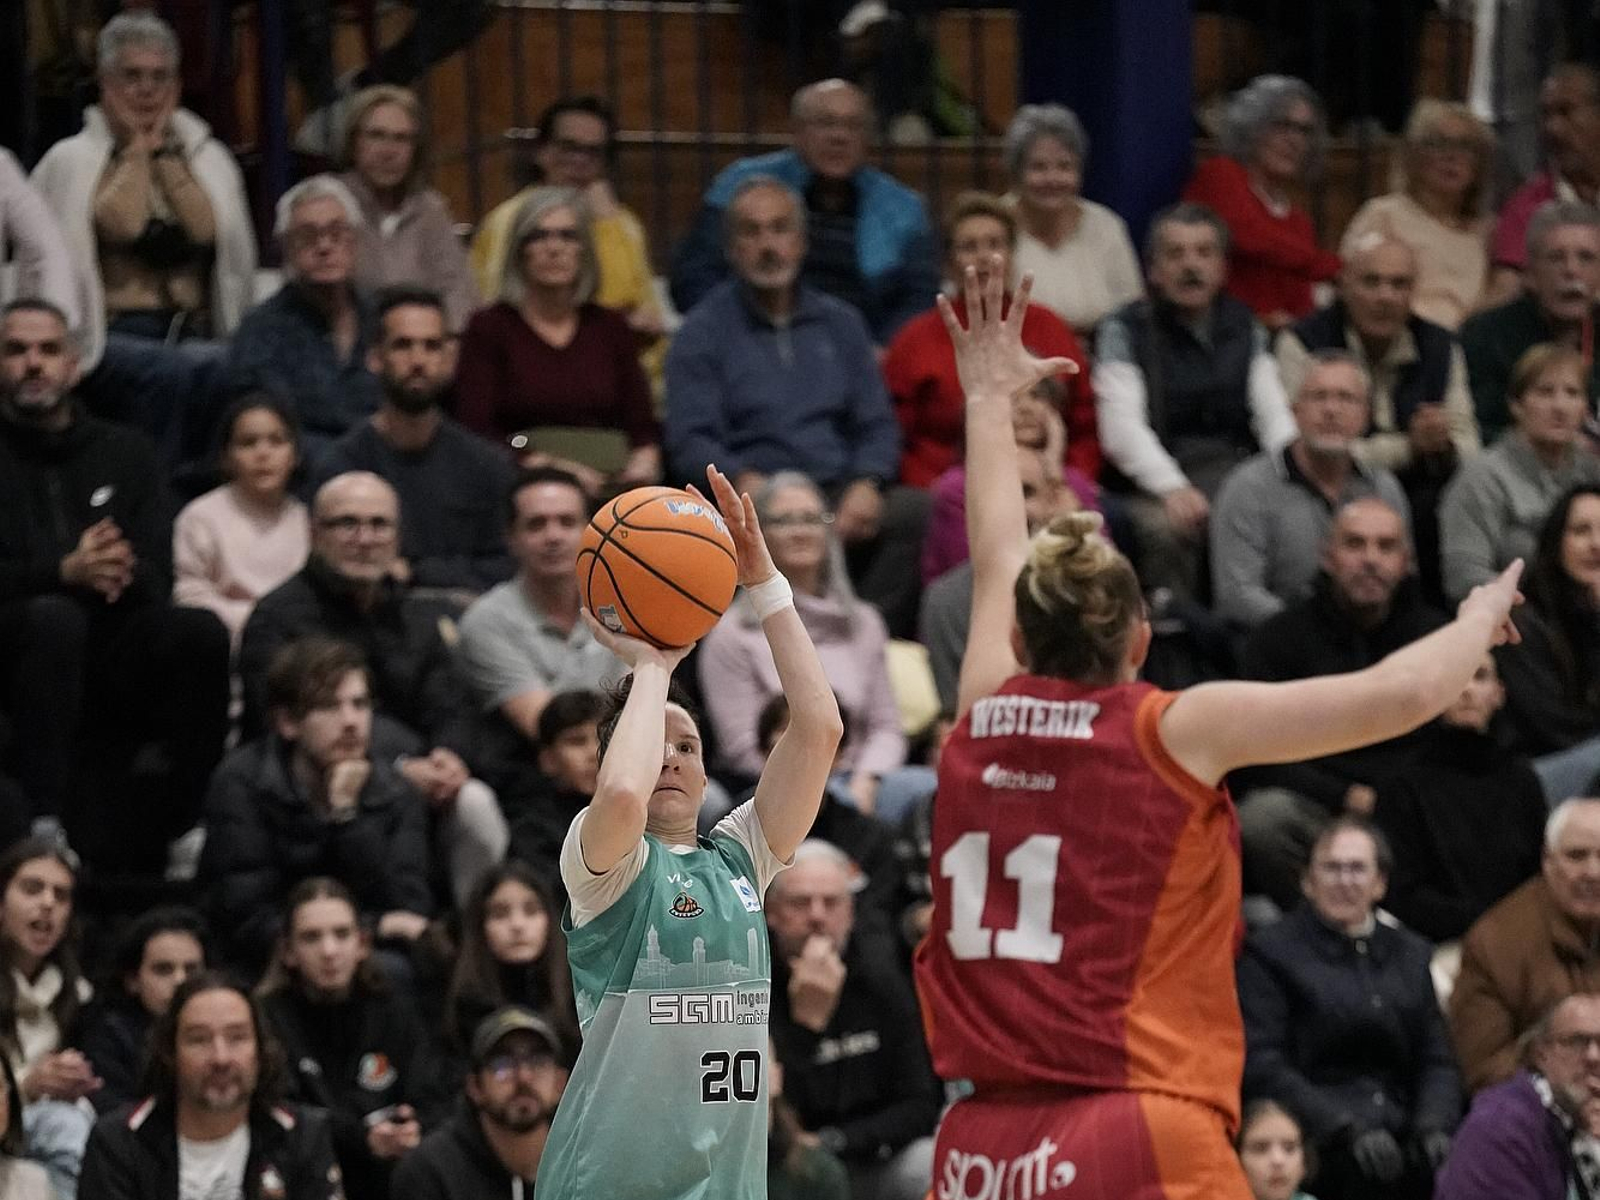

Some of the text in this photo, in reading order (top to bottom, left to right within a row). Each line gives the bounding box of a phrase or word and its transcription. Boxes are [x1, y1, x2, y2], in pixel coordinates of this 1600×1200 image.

[970, 695, 1100, 740] WESTERIK
[667, 873, 693, 888] vie
[941, 832, 1063, 964] 11
[650, 993, 734, 1024] SGM
[700, 1049, 761, 1104] 20
